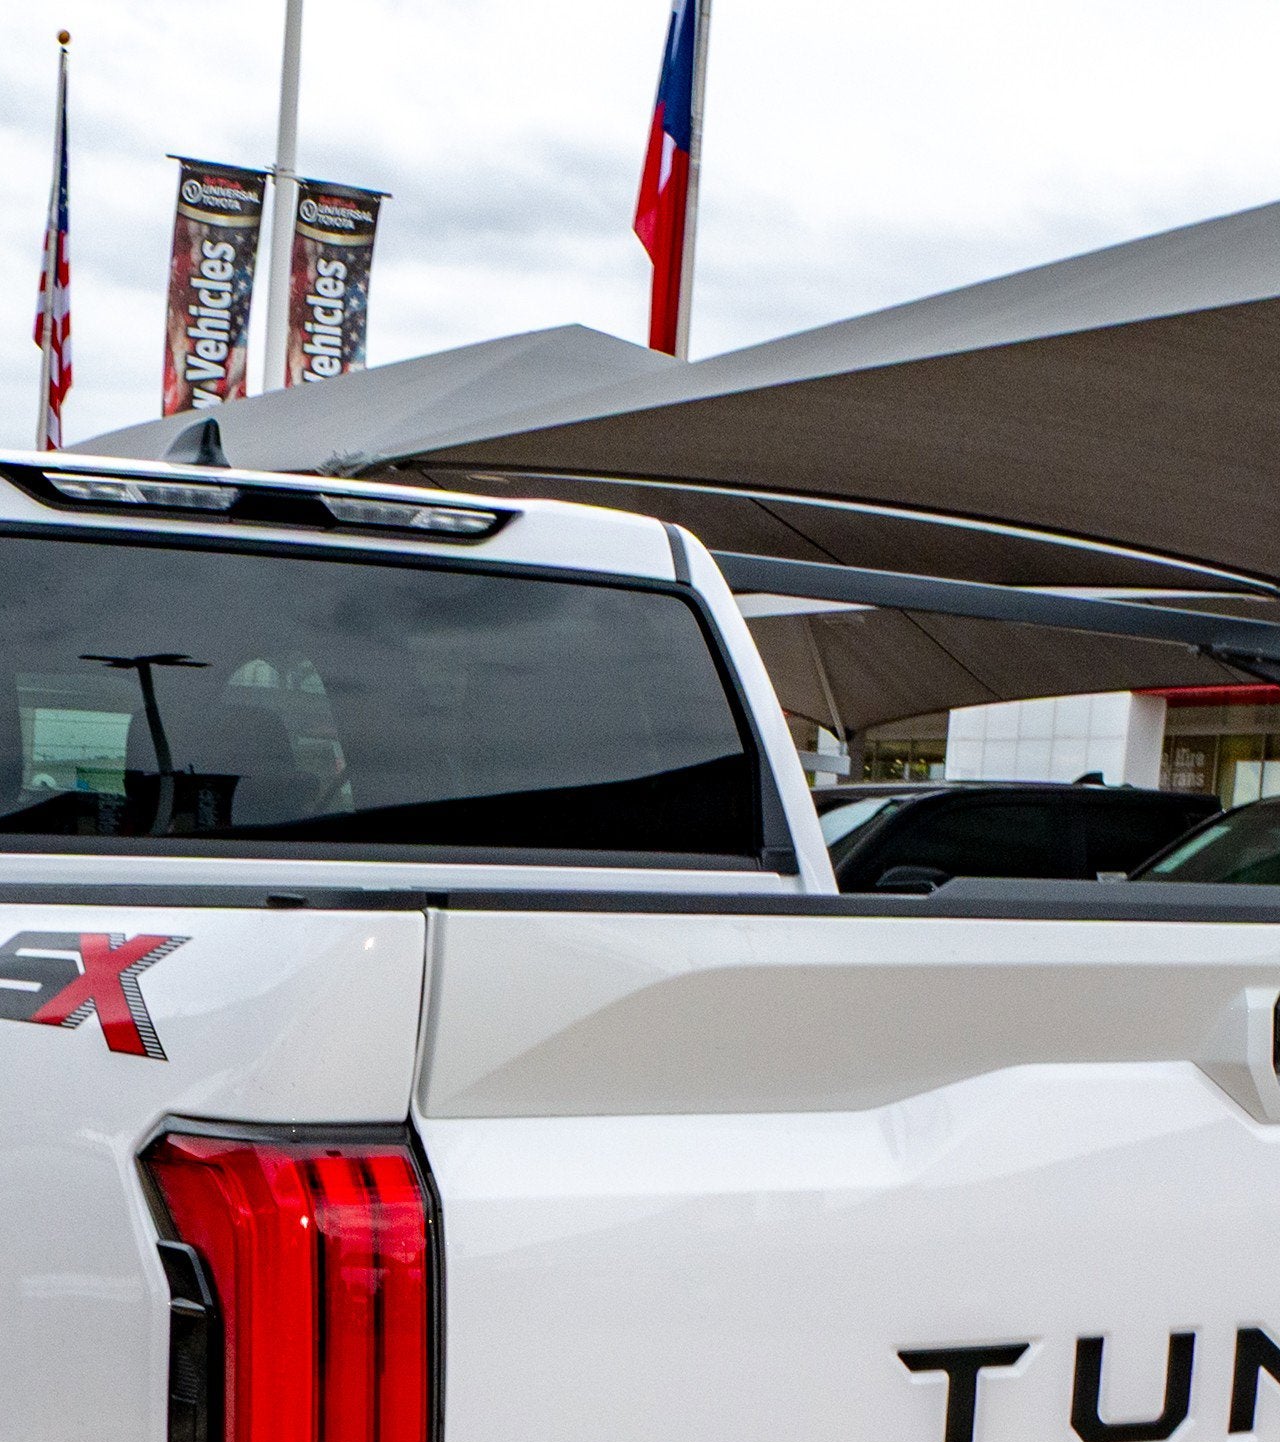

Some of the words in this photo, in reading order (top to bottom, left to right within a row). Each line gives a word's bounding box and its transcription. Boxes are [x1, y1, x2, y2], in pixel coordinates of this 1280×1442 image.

[202, 183, 261, 204] UNIVERSAL
[202, 194, 242, 212] TOYOTA
[317, 203, 374, 223] UNIVERSAL
[317, 213, 356, 230] TOYOTA
[185, 239, 236, 381] Vehicles
